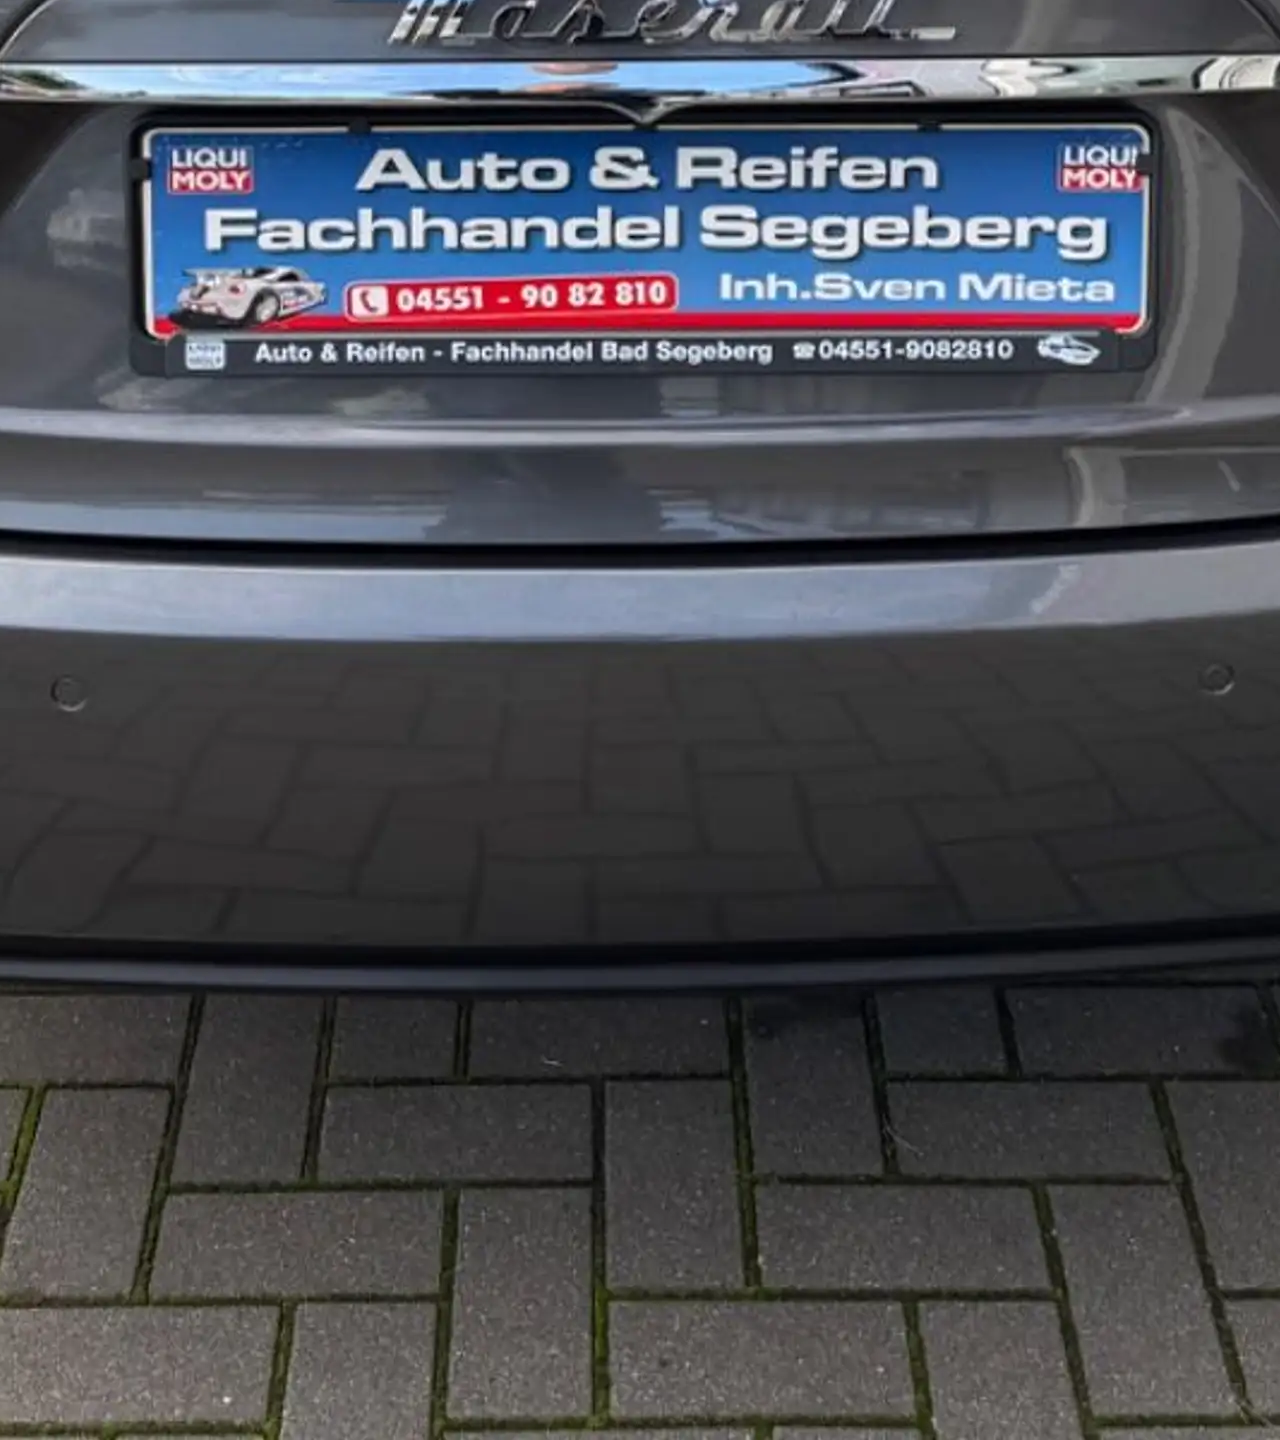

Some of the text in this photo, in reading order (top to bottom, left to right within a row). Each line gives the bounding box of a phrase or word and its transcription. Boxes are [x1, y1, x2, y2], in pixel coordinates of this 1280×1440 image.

[172, 147, 247, 168] LIQUI
[1063, 145, 1137, 166] LIQUI
[172, 171, 250, 191] MOLY
[355, 146, 938, 192] Auto & Reifen
[1062, 168, 1136, 189] MOLY
[204, 204, 1108, 260] Fachhandel Segeberg
[396, 287, 484, 313] 04551
[521, 284, 559, 308] 90
[568, 283, 605, 307] 82
[614, 280, 667, 304] 810
[958, 273, 1116, 301] Mieta
[255, 342, 313, 362] Auto
[320, 343, 337, 362] &
[346, 342, 425, 362] Reifen
[451, 341, 594, 361] Fachhandel
[602, 342, 649, 361] Bad
[656, 341, 773, 365] Segeberg
